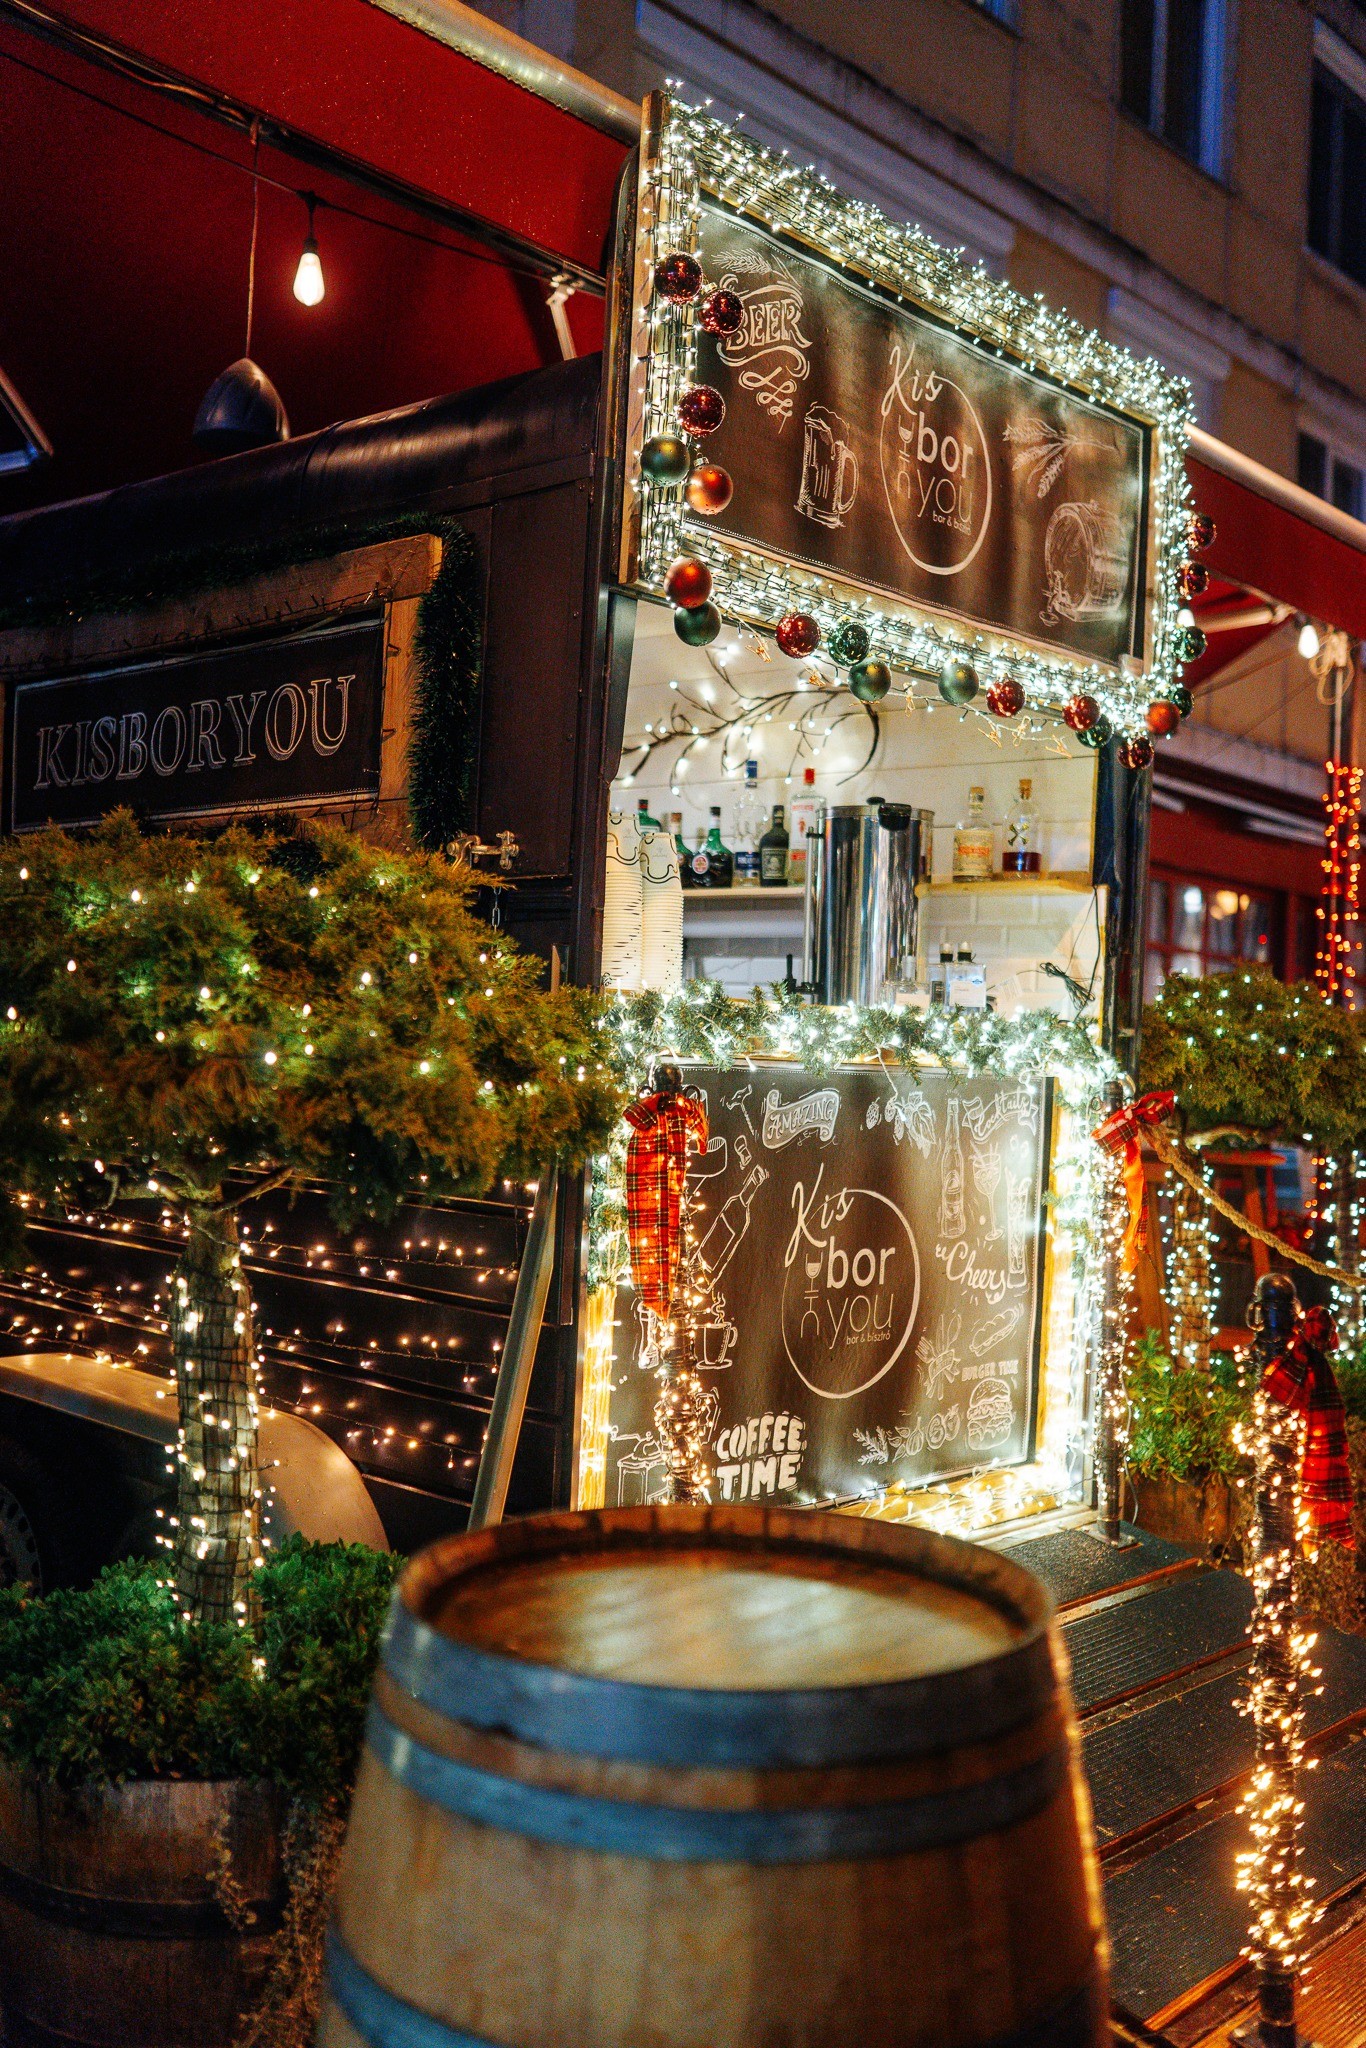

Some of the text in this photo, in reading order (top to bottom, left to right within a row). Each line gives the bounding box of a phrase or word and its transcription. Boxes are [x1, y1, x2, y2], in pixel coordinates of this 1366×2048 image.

[725, 299, 813, 350] BEER
[881, 341, 943, 417] Kis
[917, 411, 974, 479] bor
[917, 469, 972, 524] you
[34, 675, 356, 790] KISBORYOU
[767, 1098, 835, 1140] AMAZING
[784, 1162, 854, 1268] Kis
[826, 1235, 896, 1289] bor
[826, 1293, 894, 1350] you
[846, 1335, 859, 1345] bor
[860, 1333, 866, 1343] &
[961, 1359, 1019, 1382] BURGER TIME
[716, 1414, 804, 1460] COFFEE
[716, 1453, 802, 1500] TIME
